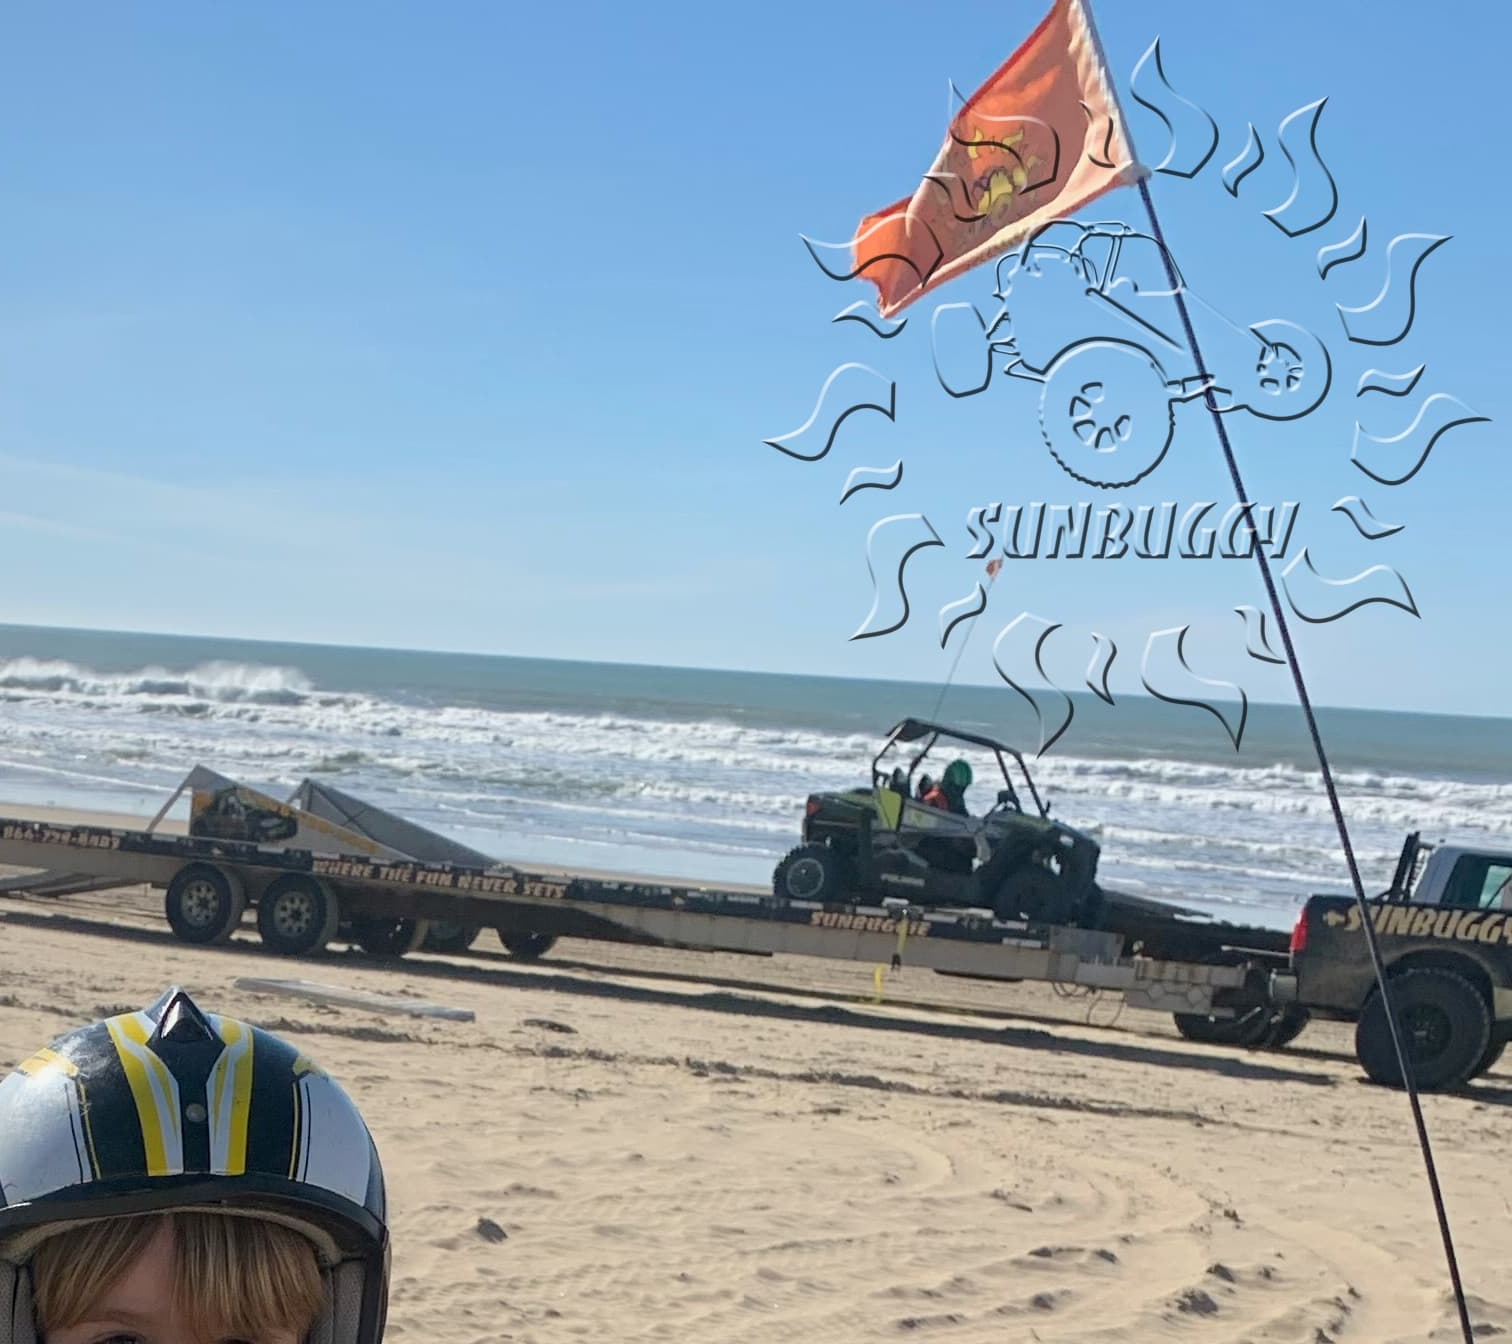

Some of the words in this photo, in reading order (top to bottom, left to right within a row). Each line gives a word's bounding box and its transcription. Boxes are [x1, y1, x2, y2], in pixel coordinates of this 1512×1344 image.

[312, 859, 374, 878] WHERE
[378, 863, 412, 883] THE
[415, 869, 454, 888] FUN
[457, 873, 518, 895] NEVER
[523, 881, 568, 899] SETS
